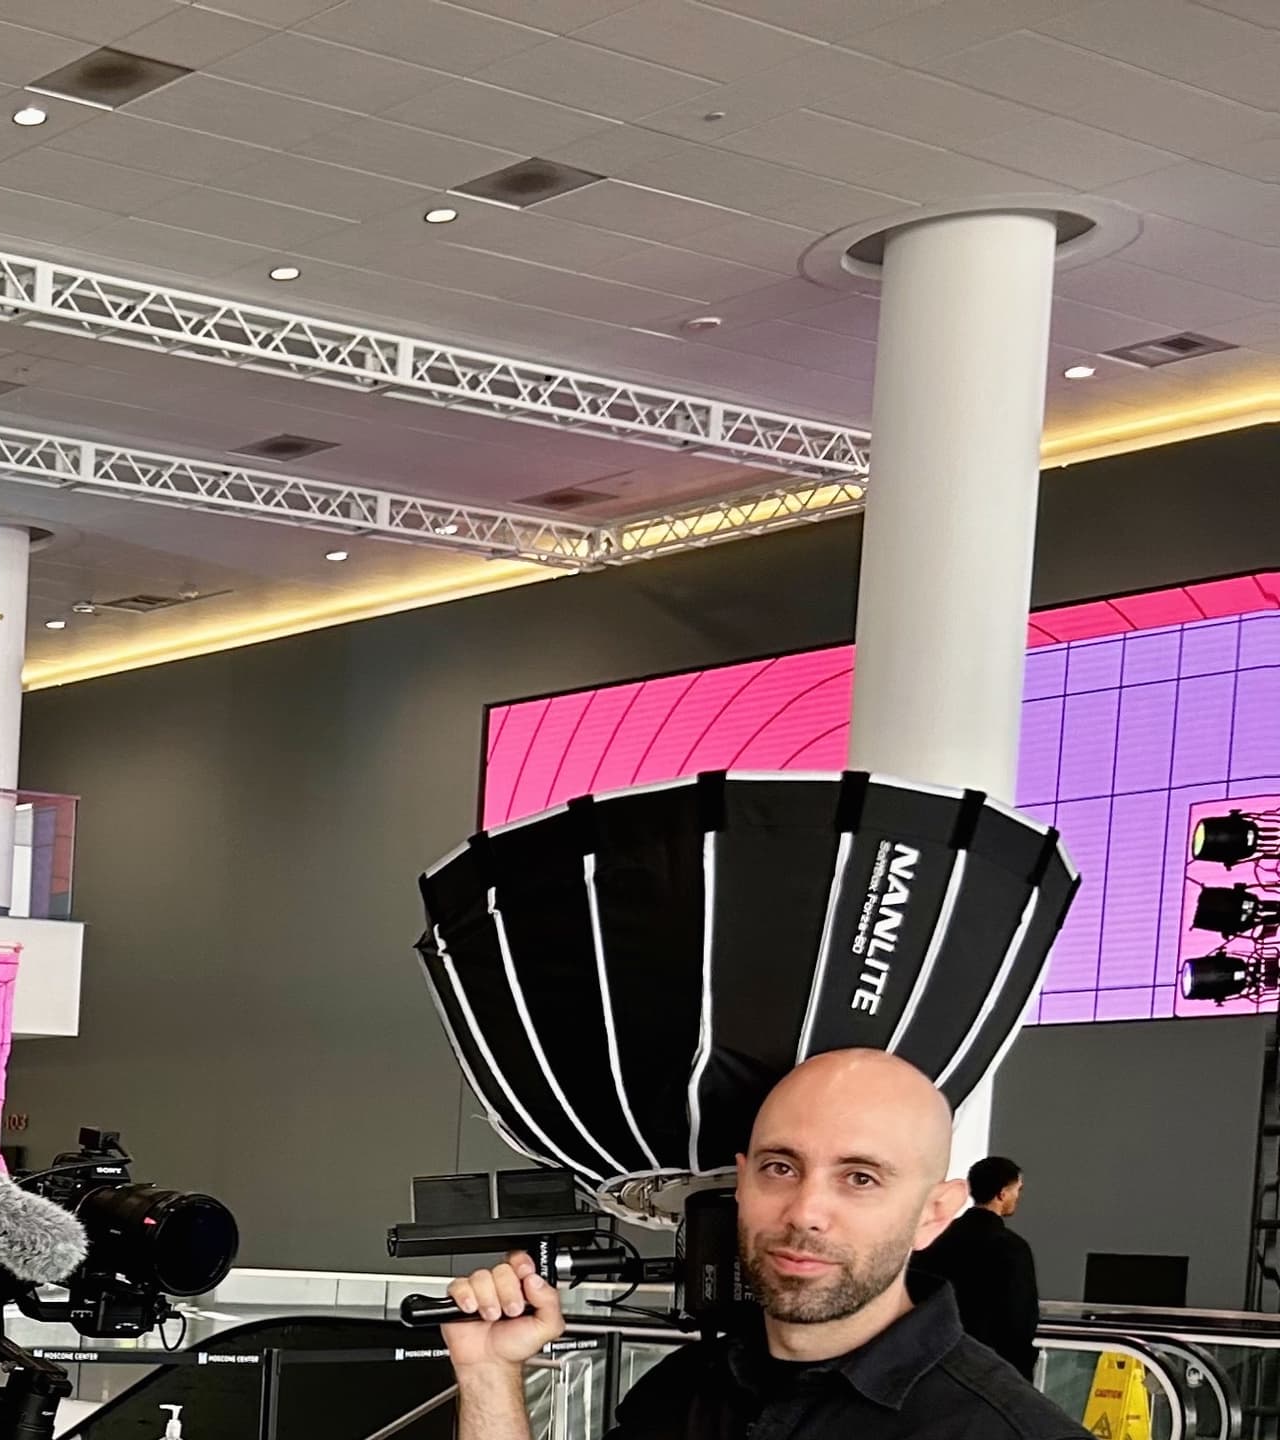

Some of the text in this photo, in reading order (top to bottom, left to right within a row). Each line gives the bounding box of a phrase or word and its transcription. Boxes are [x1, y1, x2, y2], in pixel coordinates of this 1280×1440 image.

[851, 843, 920, 1016] NANLITE
[96, 1166, 122, 1175] SONY
[540, 1241, 549, 1278] NANLITE
[552, 1339, 598, 1351] MOSCONE CENTER
[44, 1351, 98, 1361] MOSCONE CENTER
[208, 1354, 260, 1364] MOSCONE CENTER
[405, 1350, 430, 1359] MOSCONE
